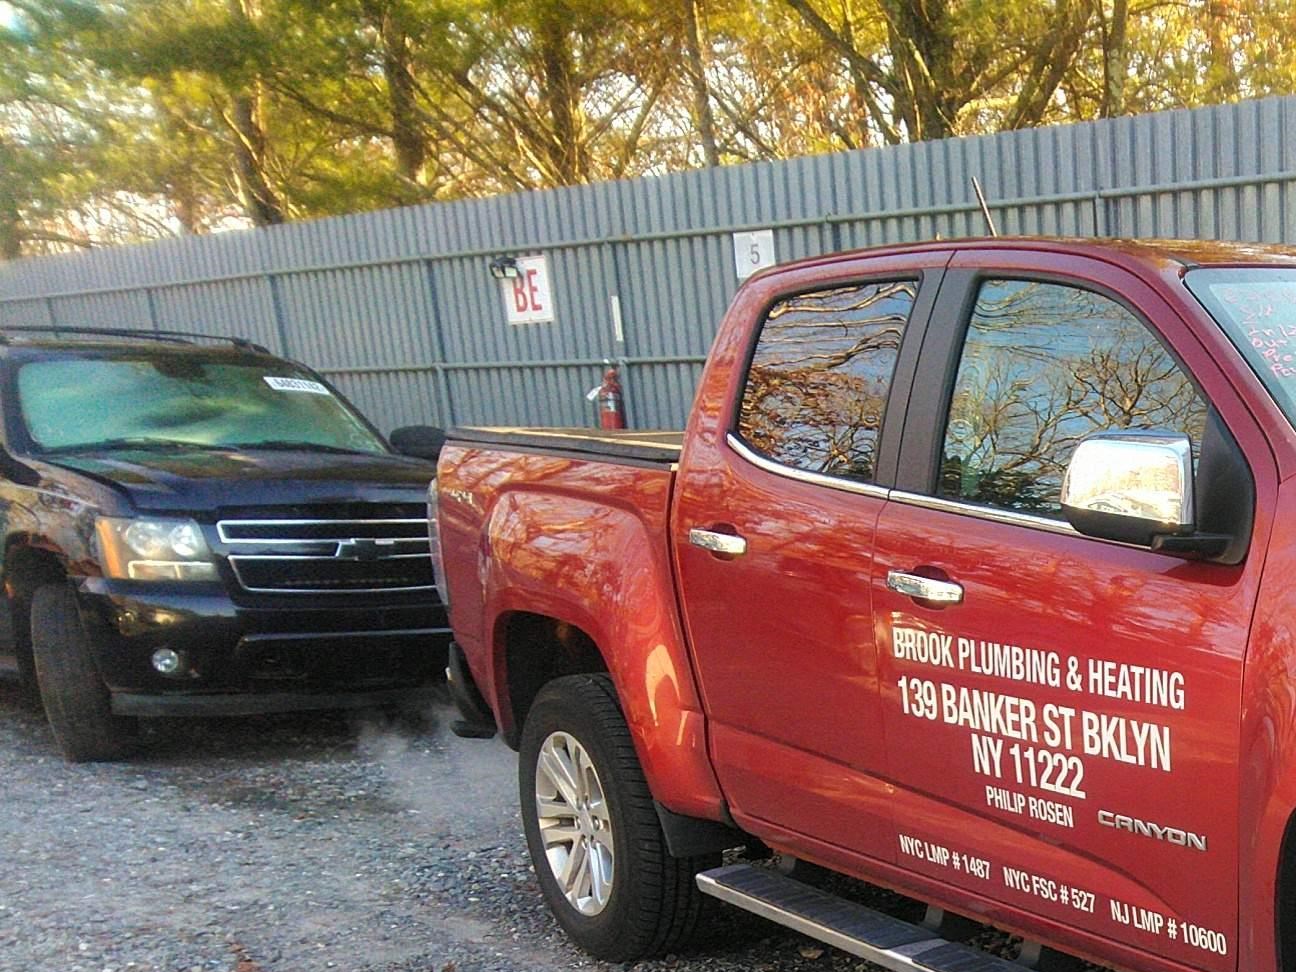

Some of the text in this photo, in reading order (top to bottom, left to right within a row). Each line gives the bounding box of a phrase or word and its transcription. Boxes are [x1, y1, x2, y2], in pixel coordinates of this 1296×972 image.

[750, 243, 760, 265] 5
[512, 269, 543, 312] BE
[892, 626, 1185, 710] BROOK PLUMBING & HEATING
[898, 675, 1171, 772] 139 BANKER ST BKLYN
[971, 733, 1087, 799] NY 11222
[985, 785, 1074, 828] PHILIP ROSEN
[1097, 809, 1208, 851] CANYON
[899, 834, 1227, 956] NYC LMP # 1487 NYC FSC # 527 NJ LMP # 10600
